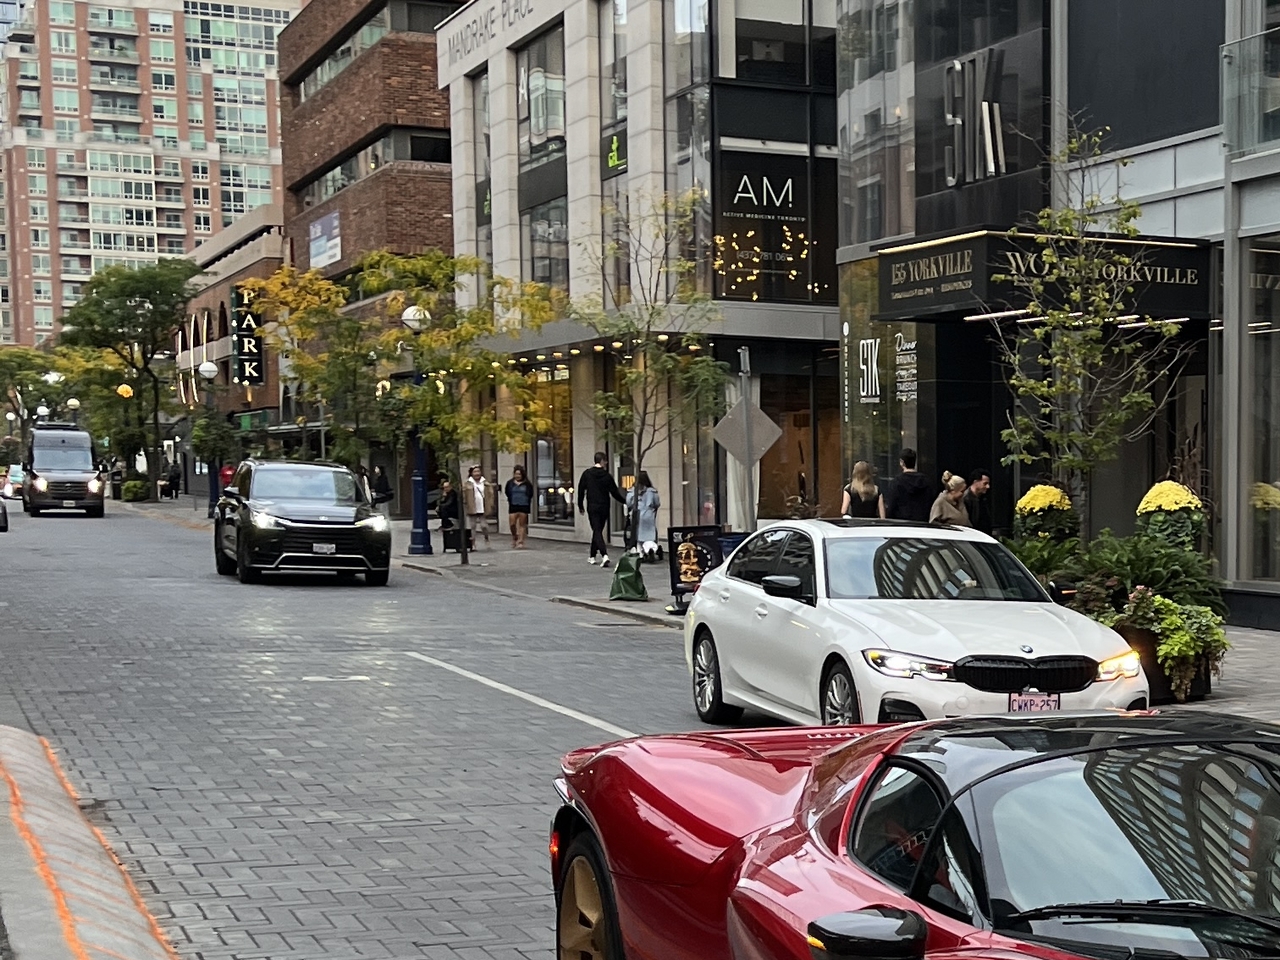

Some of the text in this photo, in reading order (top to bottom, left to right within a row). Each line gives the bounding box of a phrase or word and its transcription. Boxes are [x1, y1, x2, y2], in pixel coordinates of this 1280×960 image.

[448, 5, 497, 66] MANDRAKE
[944, 46, 1007, 187] STK
[891, 262, 907, 286] 155
[908, 250, 973, 282] YORKVILLE
[241, 289, 259, 378] PARK
[860, 338, 881, 396] STK
